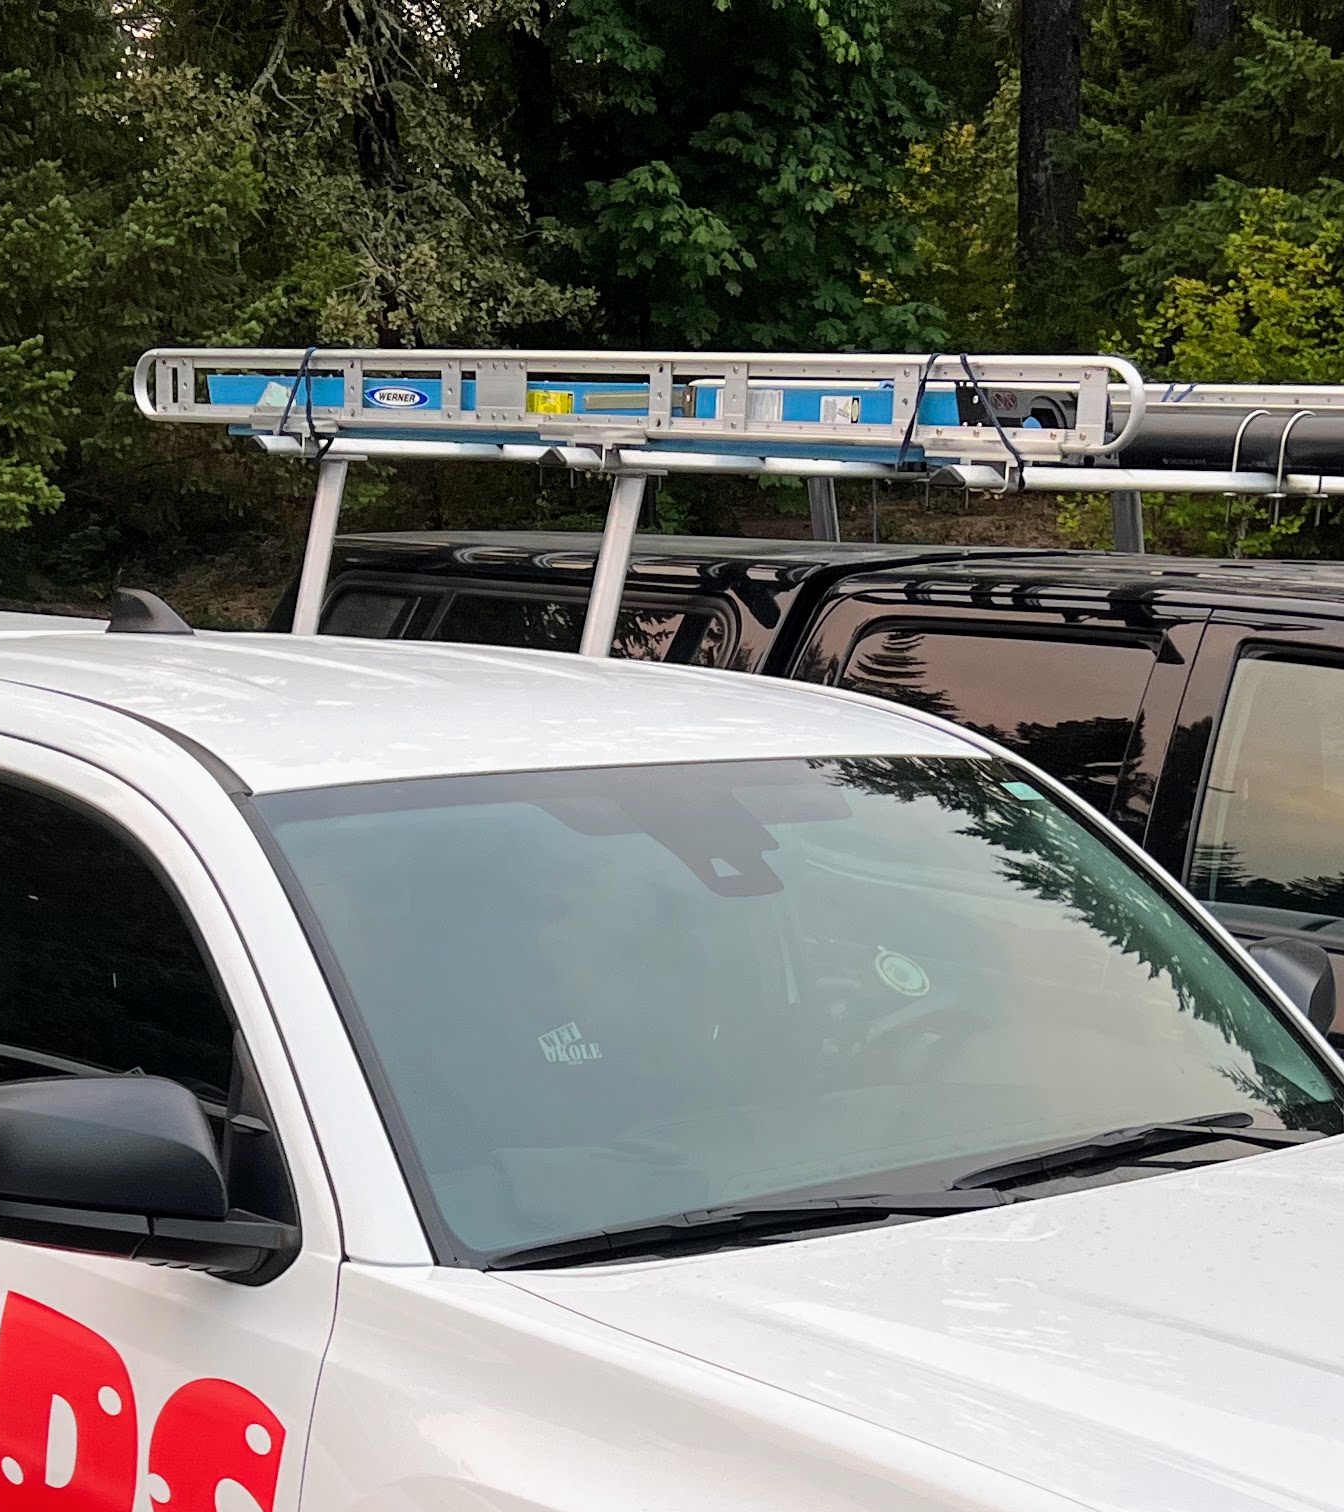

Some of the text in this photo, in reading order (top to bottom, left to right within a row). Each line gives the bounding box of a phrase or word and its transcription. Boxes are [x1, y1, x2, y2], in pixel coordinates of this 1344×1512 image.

[378, 392, 416, 403] WERNER
[542, 1025, 577, 1048] WET
[544, 1043, 603, 1063] OKOLE
